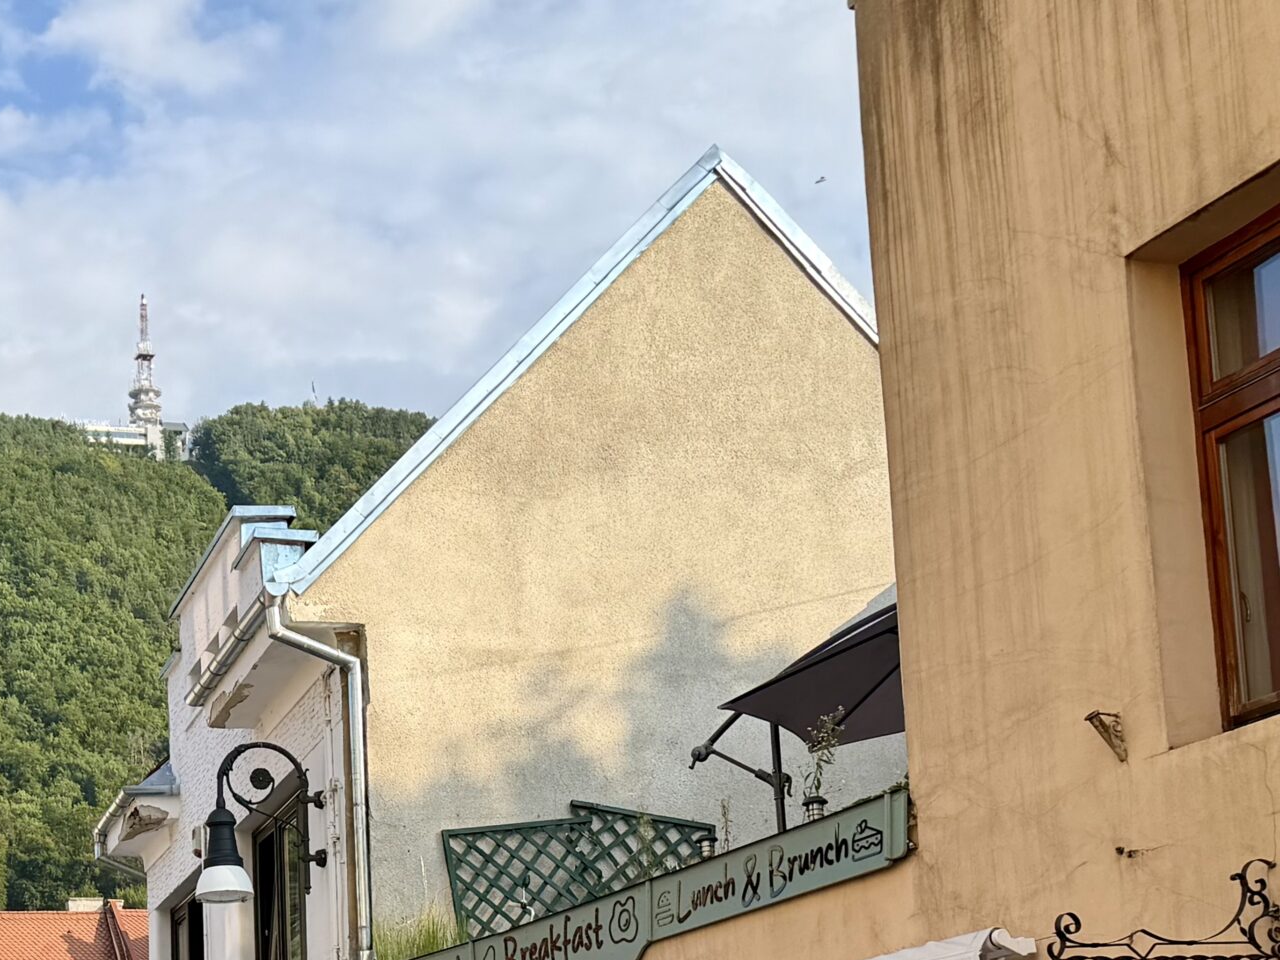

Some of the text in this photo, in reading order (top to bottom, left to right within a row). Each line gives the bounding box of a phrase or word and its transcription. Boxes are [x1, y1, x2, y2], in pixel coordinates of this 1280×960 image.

[676, 822, 849, 924] Lunch & Brunch
